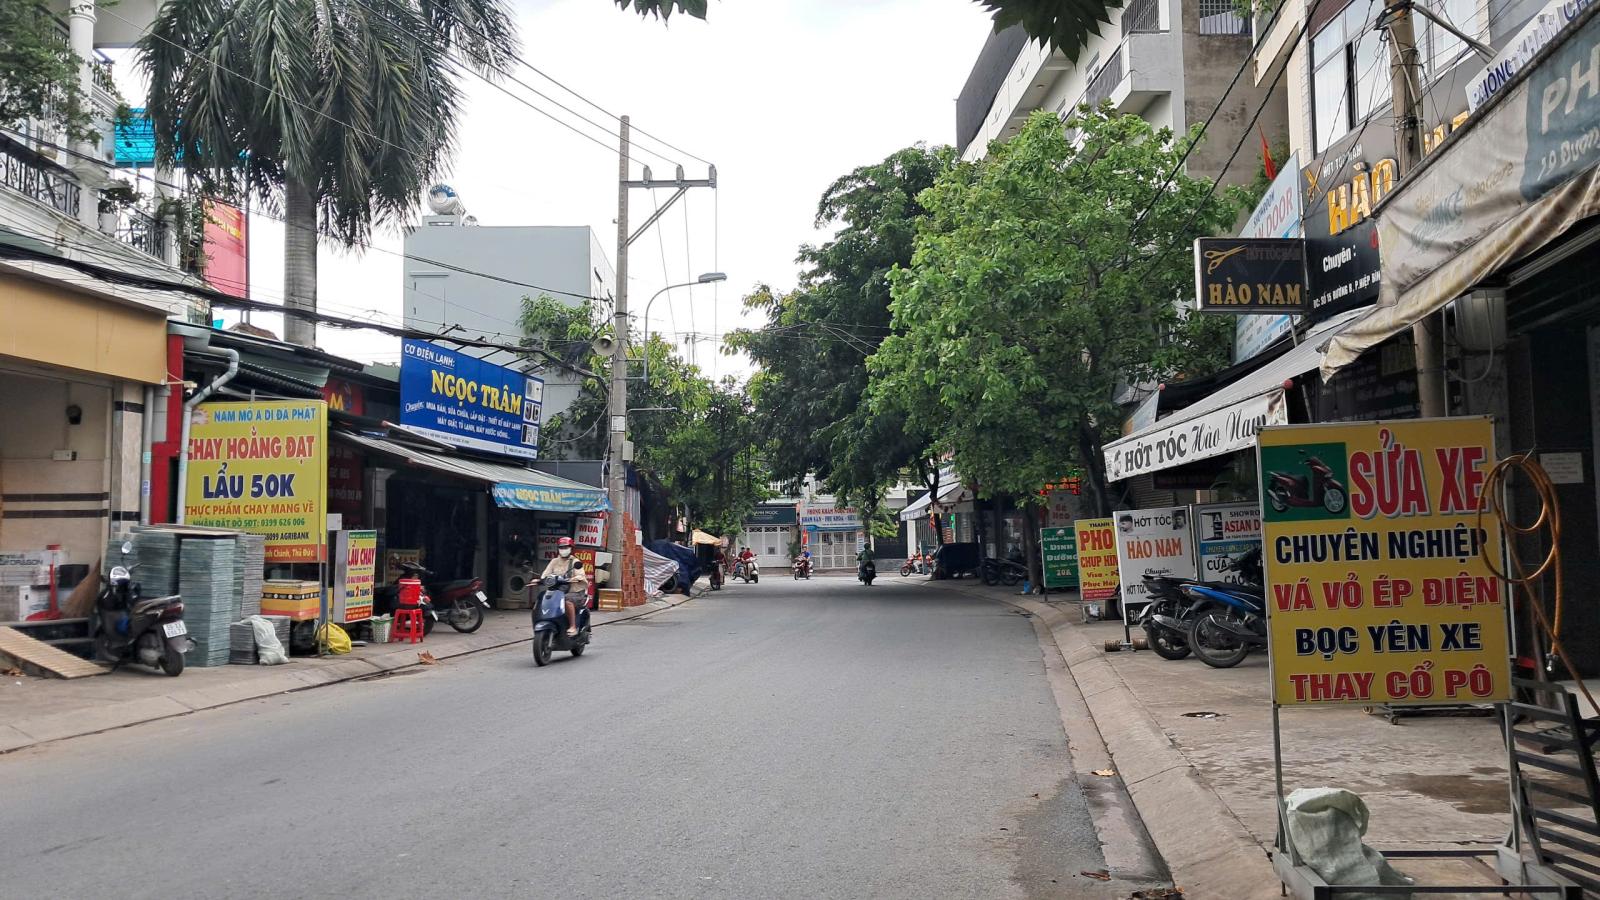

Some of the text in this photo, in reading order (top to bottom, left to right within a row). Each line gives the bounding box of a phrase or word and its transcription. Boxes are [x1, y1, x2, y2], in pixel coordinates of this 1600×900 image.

[1266, 186, 1293, 238] DOOR
[1323, 247, 1352, 272] Chuyên
[1208, 276, 1302, 305] HÀO NAM
[404, 343, 416, 353] CƠ
[415, 345, 436, 361] ĐIỆN
[431, 369, 522, 416] NGỌC TRÂM
[214, 409, 236, 422] NAM
[238, 406, 254, 421] MÔ
[291, 404, 316, 423] PHẬT
[285, 435, 315, 465] ĐẠT
[1124, 441, 1153, 473] HỚT
[1156, 430, 1187, 464] TÓC
[203, 461, 244, 500] LẨU
[250, 473, 295, 499] 50K
[1350, 428, 1490, 519] SỬA XE
[243, 503, 268, 515] CHAY
[270, 502, 299, 514] MANG
[302, 499, 314, 513] VỀ
[260, 517, 278, 527] 0399
[278, 517, 291, 527] 626
[280, 531, 310, 541] AGRIBANK
[578, 524, 599, 534] MUA
[1225, 519, 1252, 533] ASIAN
[578, 534, 598, 544] BÁN
[1127, 536, 1183, 560] HÀO NAM
[1275, 522, 1488, 564] CHUYÊN NGHIỆP
[1273, 571, 1501, 612] VÁ VỎ ÉP ĐIỆN
[1295, 618, 1483, 661] BỌC YÊN XE
[1289, 659, 1494, 702] THAY CỔ PÔ
